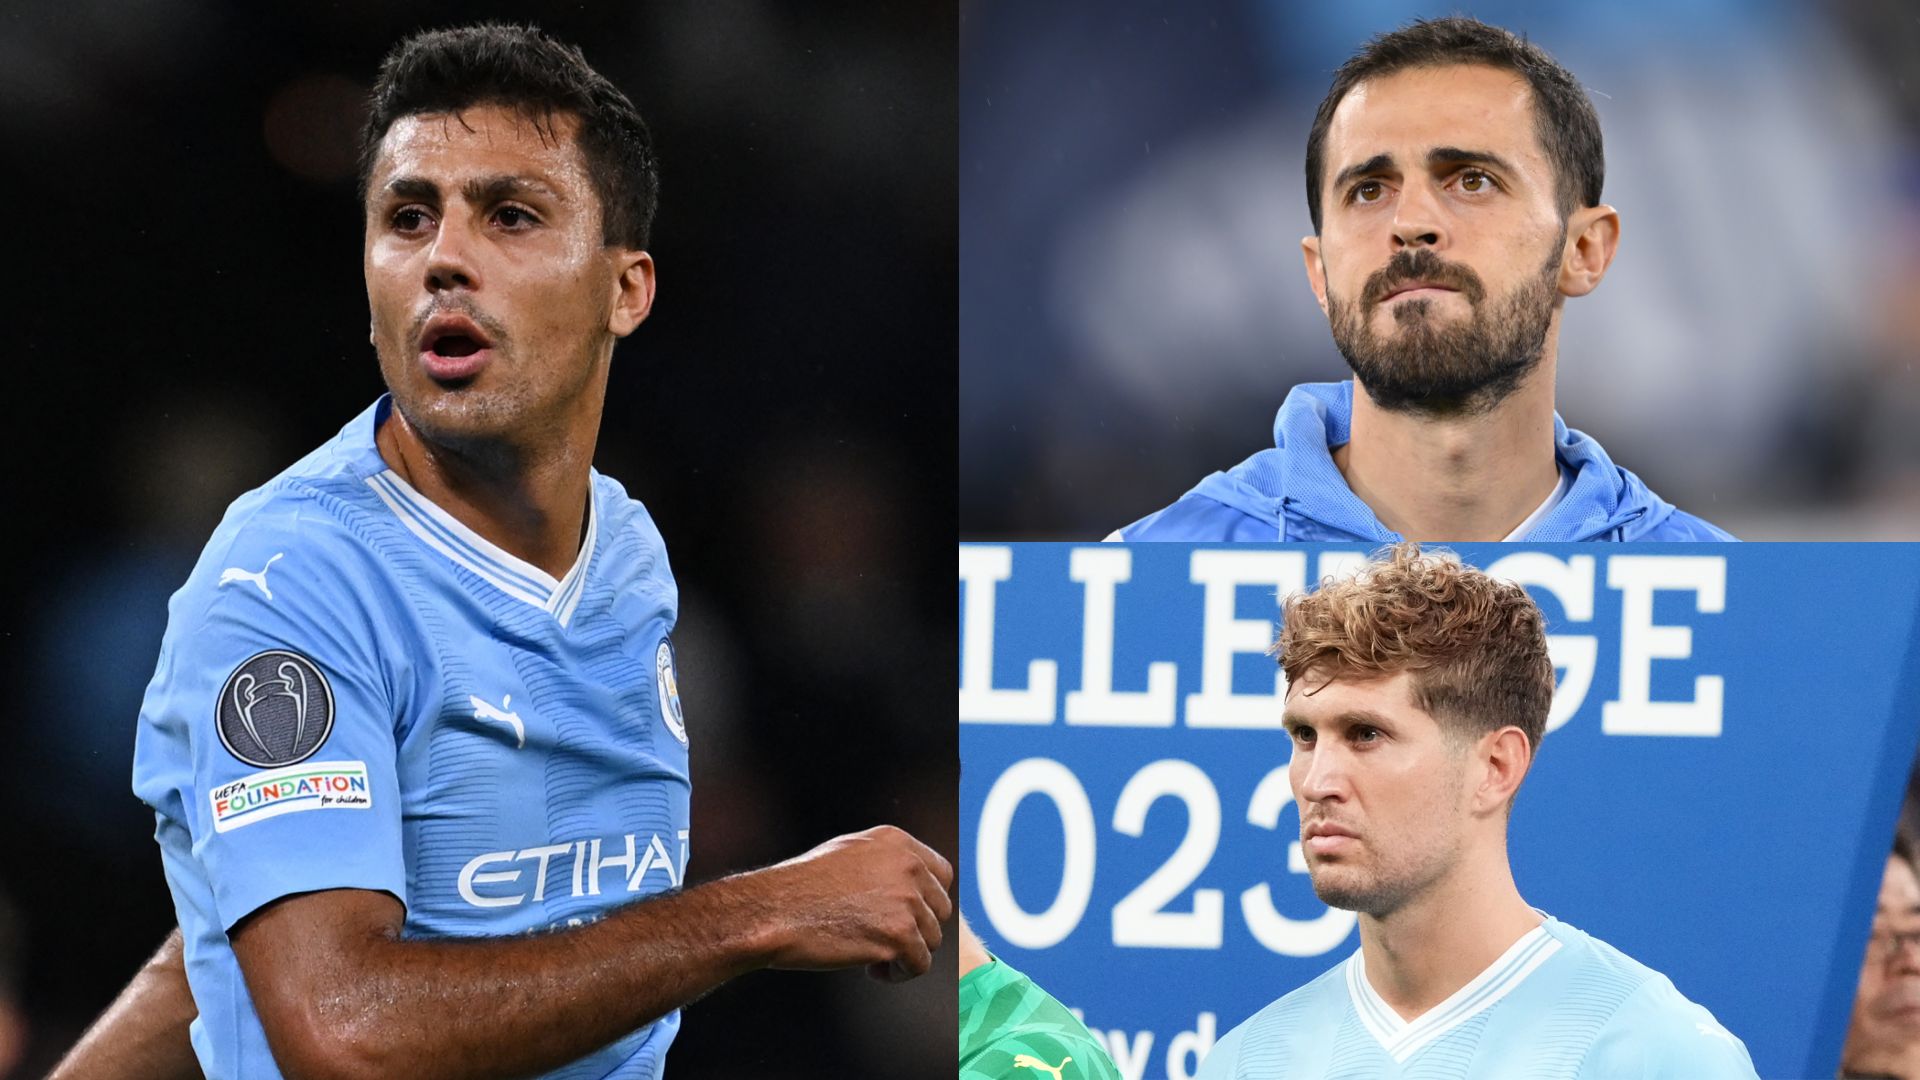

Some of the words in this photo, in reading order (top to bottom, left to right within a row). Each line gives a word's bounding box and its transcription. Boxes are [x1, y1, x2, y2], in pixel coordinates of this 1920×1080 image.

[214, 782, 246, 800] UEFA
[321, 795, 333, 806] for
[336, 795, 367, 805] children
[974, 756, 1358, 958] 023
